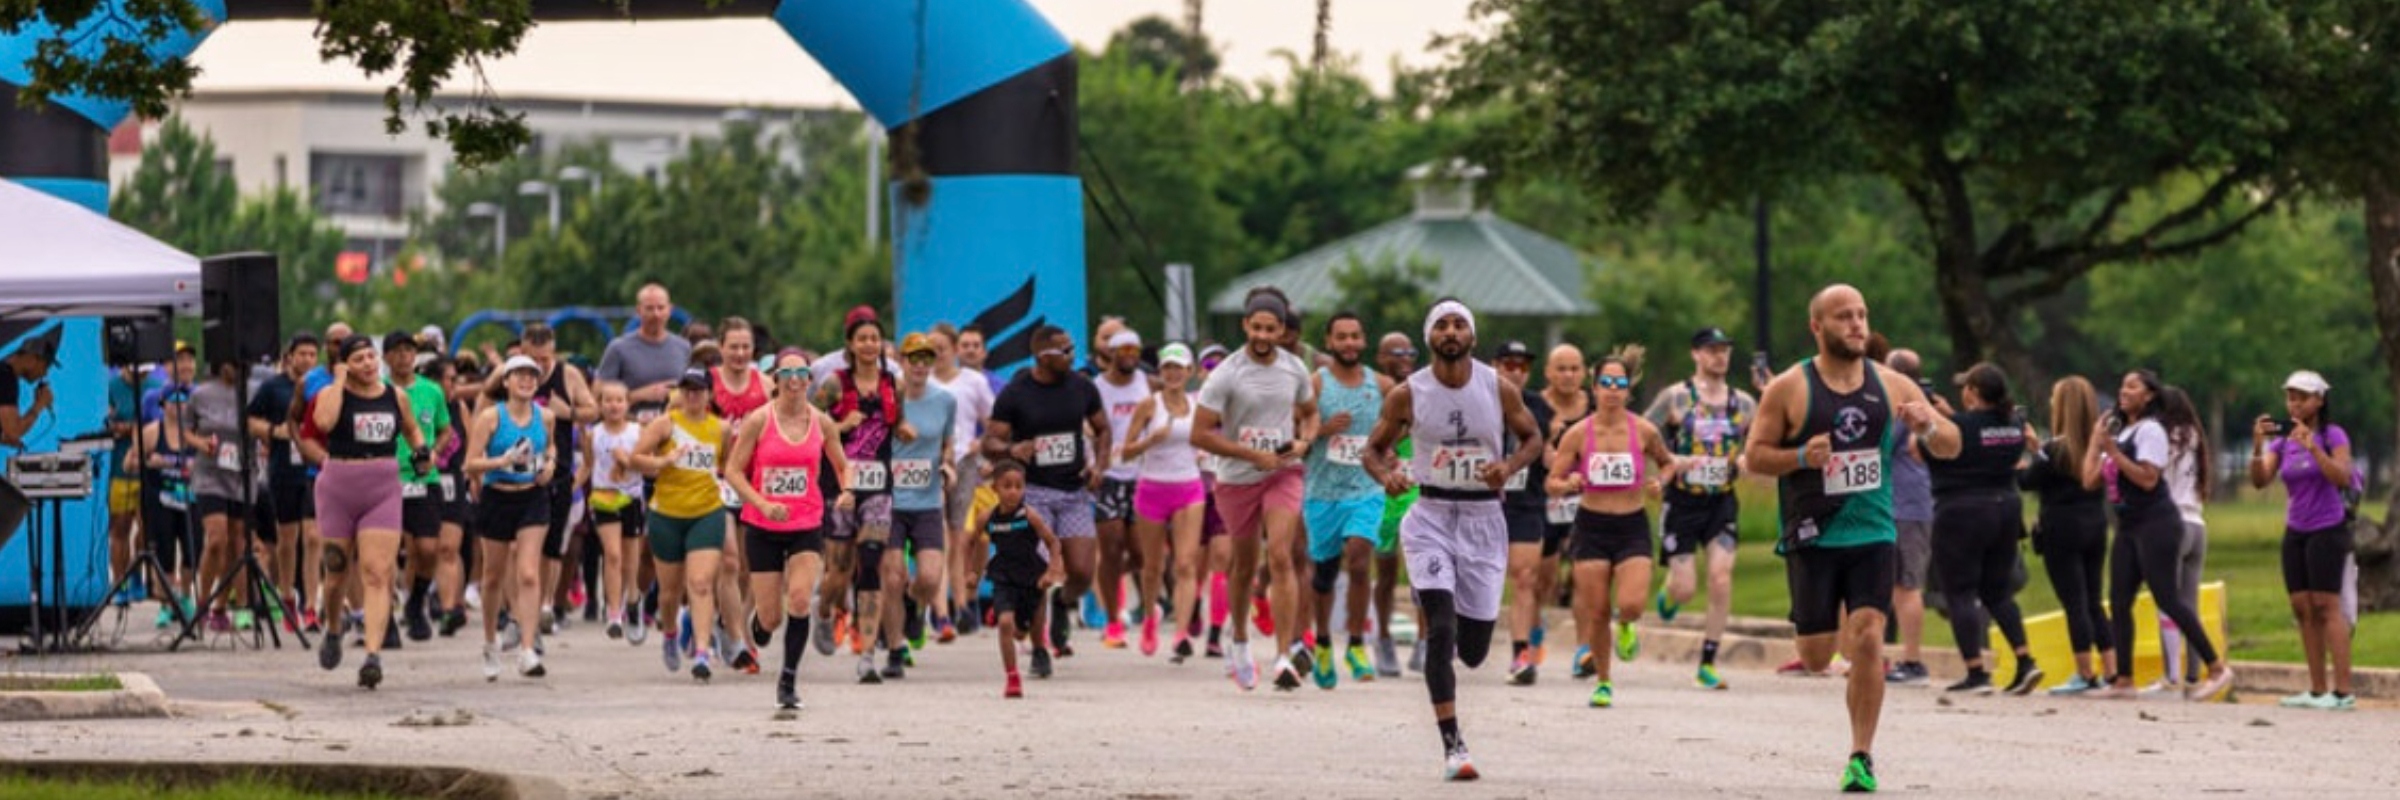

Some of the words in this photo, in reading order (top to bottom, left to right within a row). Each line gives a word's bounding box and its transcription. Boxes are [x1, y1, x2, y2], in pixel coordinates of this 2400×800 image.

[688, 451, 714, 468] 130
[1048, 441, 1074, 460] 125
[858, 470, 883, 485] 141
[901, 469, 931, 485] 209
[1601, 462, 1632, 480] 143
[1840, 461, 1880, 487] 188
[774, 475, 807, 493] 240
